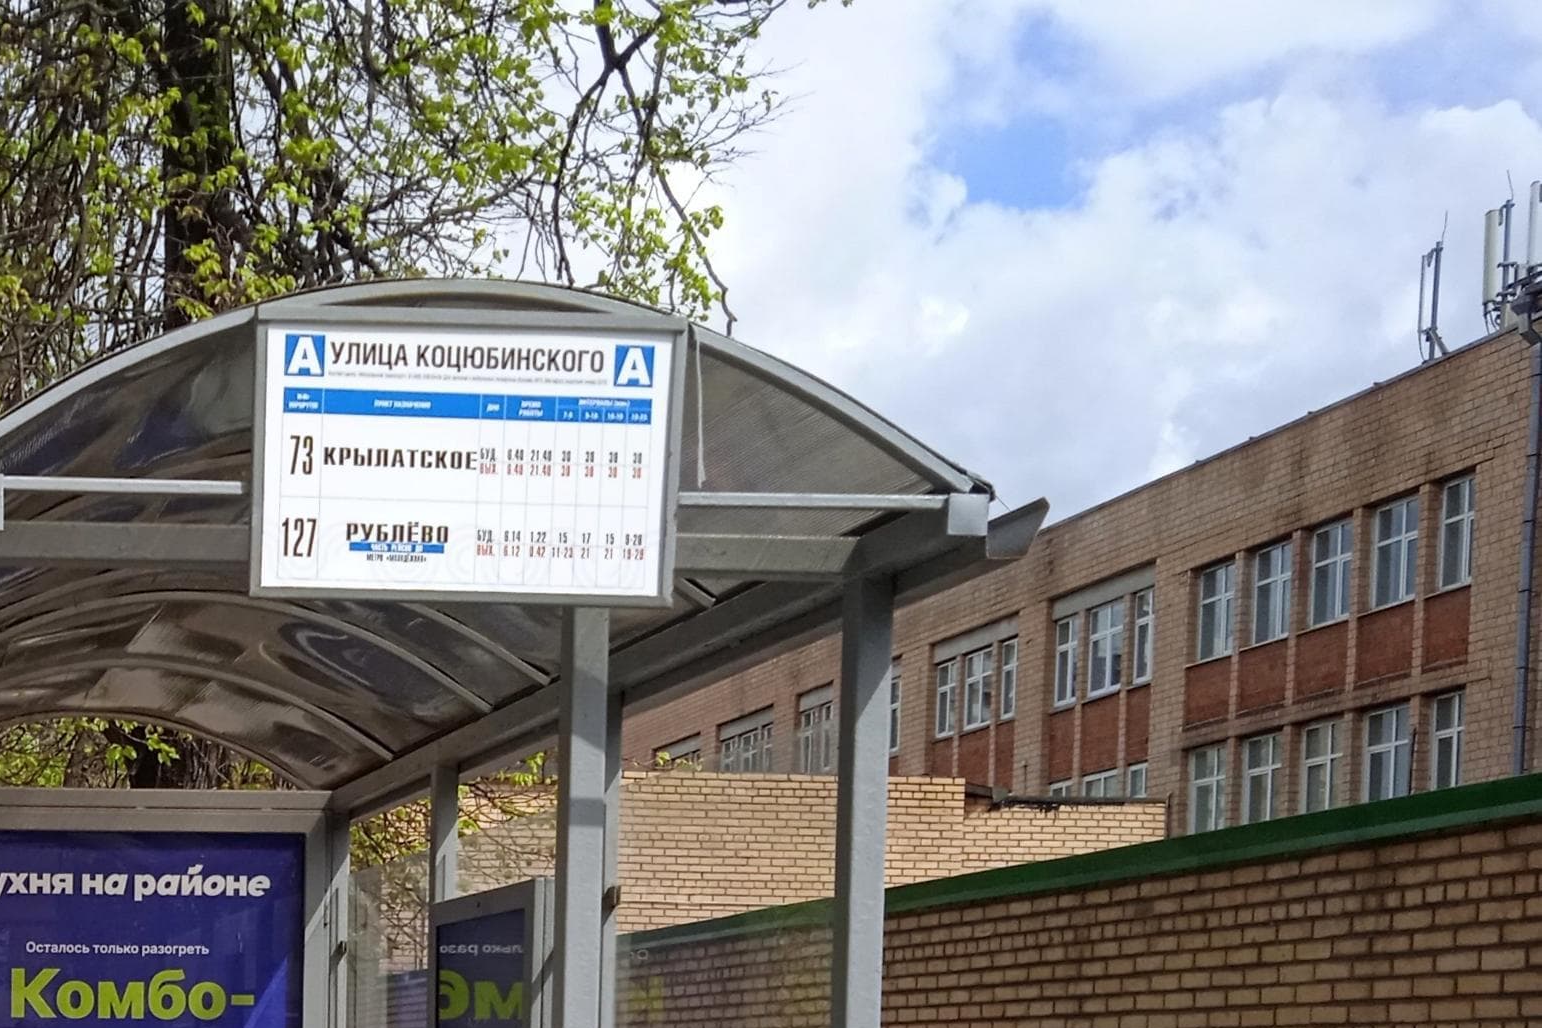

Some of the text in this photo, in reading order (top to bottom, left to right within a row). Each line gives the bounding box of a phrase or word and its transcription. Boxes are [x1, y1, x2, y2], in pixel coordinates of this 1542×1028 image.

[330, 341, 604, 373] УЛИЦА КОЦЮБИНСКОГО
[289, 435, 314, 475] 73
[323, 446, 477, 471] КРЫЛАТСКОЕ
[281, 518, 317, 557] 127
[346, 521, 449, 544] РУБЛЁВО
[559, 532, 568, 544] 15
[582, 532, 591, 544] 17
[606, 533, 615, 545] 15
[81, 872, 129, 896] на
[133, 864, 271, 901] районе
[25, 941, 209, 957] Осталось только разогреть
[10, 967, 255, 1021] Комбо-
